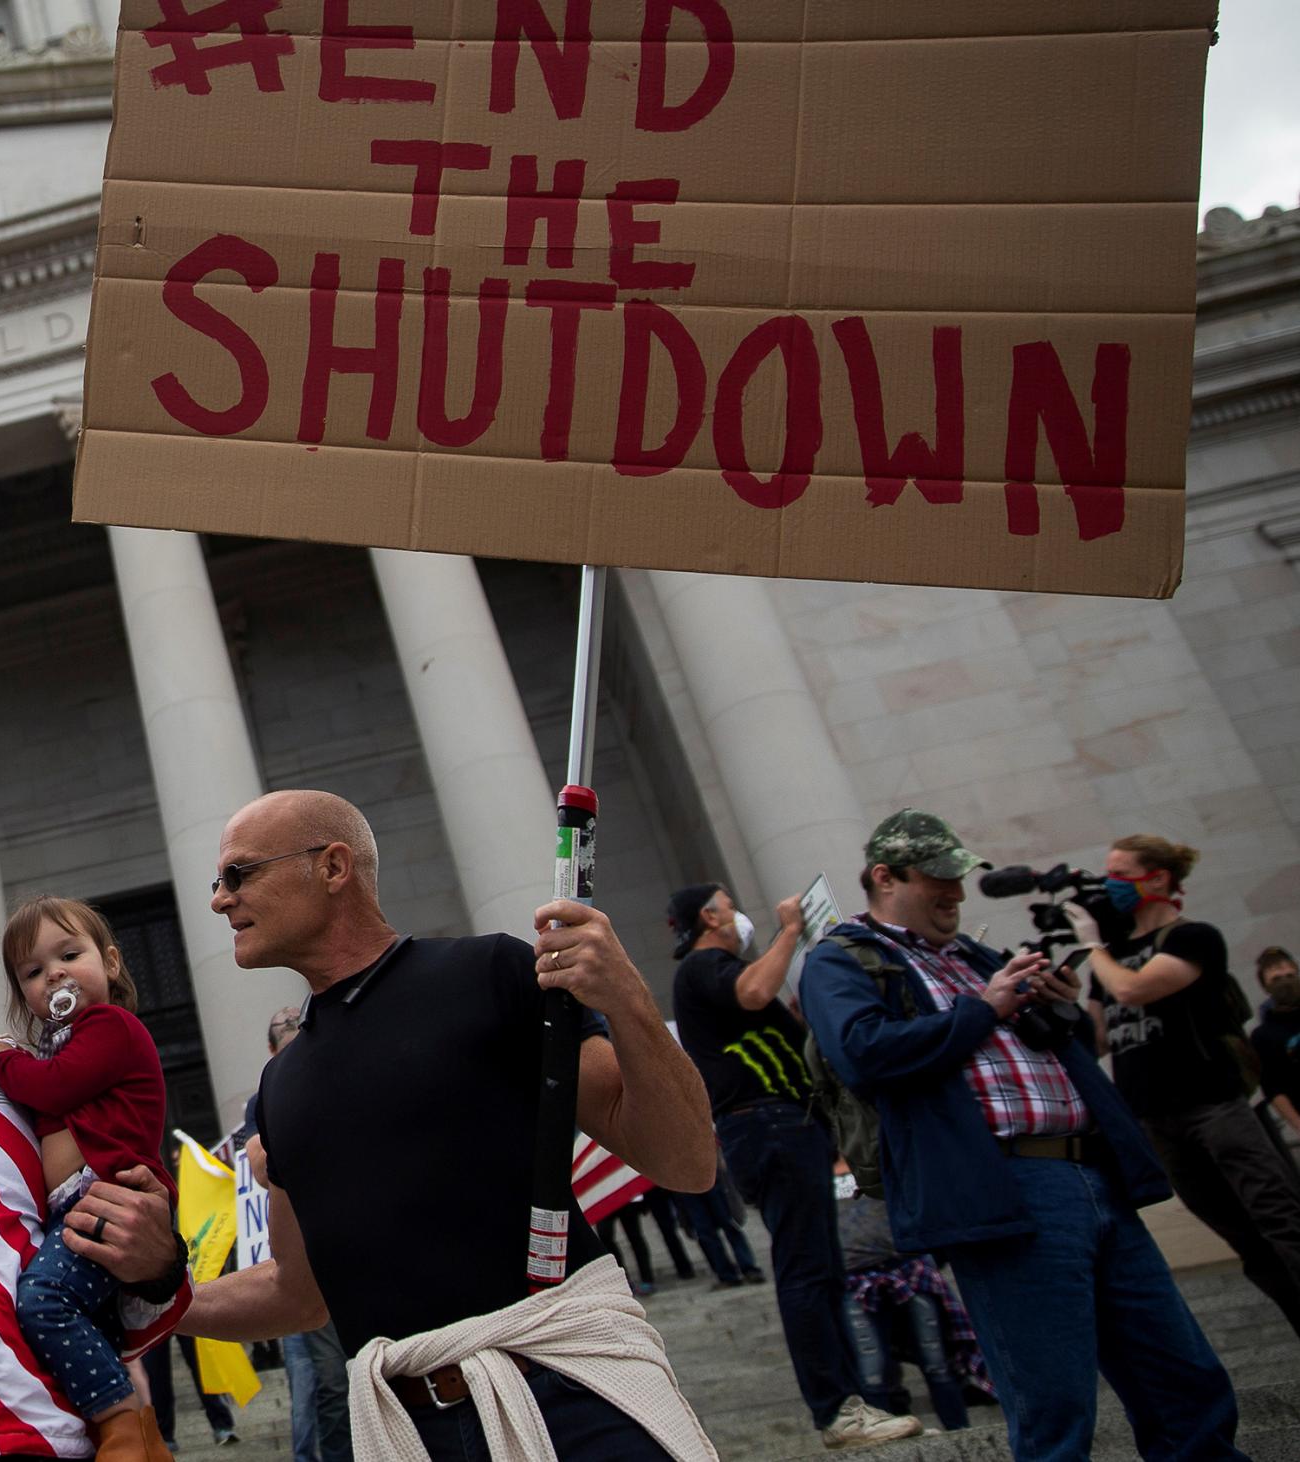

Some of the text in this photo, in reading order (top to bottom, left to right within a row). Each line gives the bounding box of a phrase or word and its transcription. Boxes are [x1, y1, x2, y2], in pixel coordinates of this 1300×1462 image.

[141, 0, 735, 133] #END
[371, 139, 696, 290] THE
[152, 234, 1130, 541] SHUTDOWN
